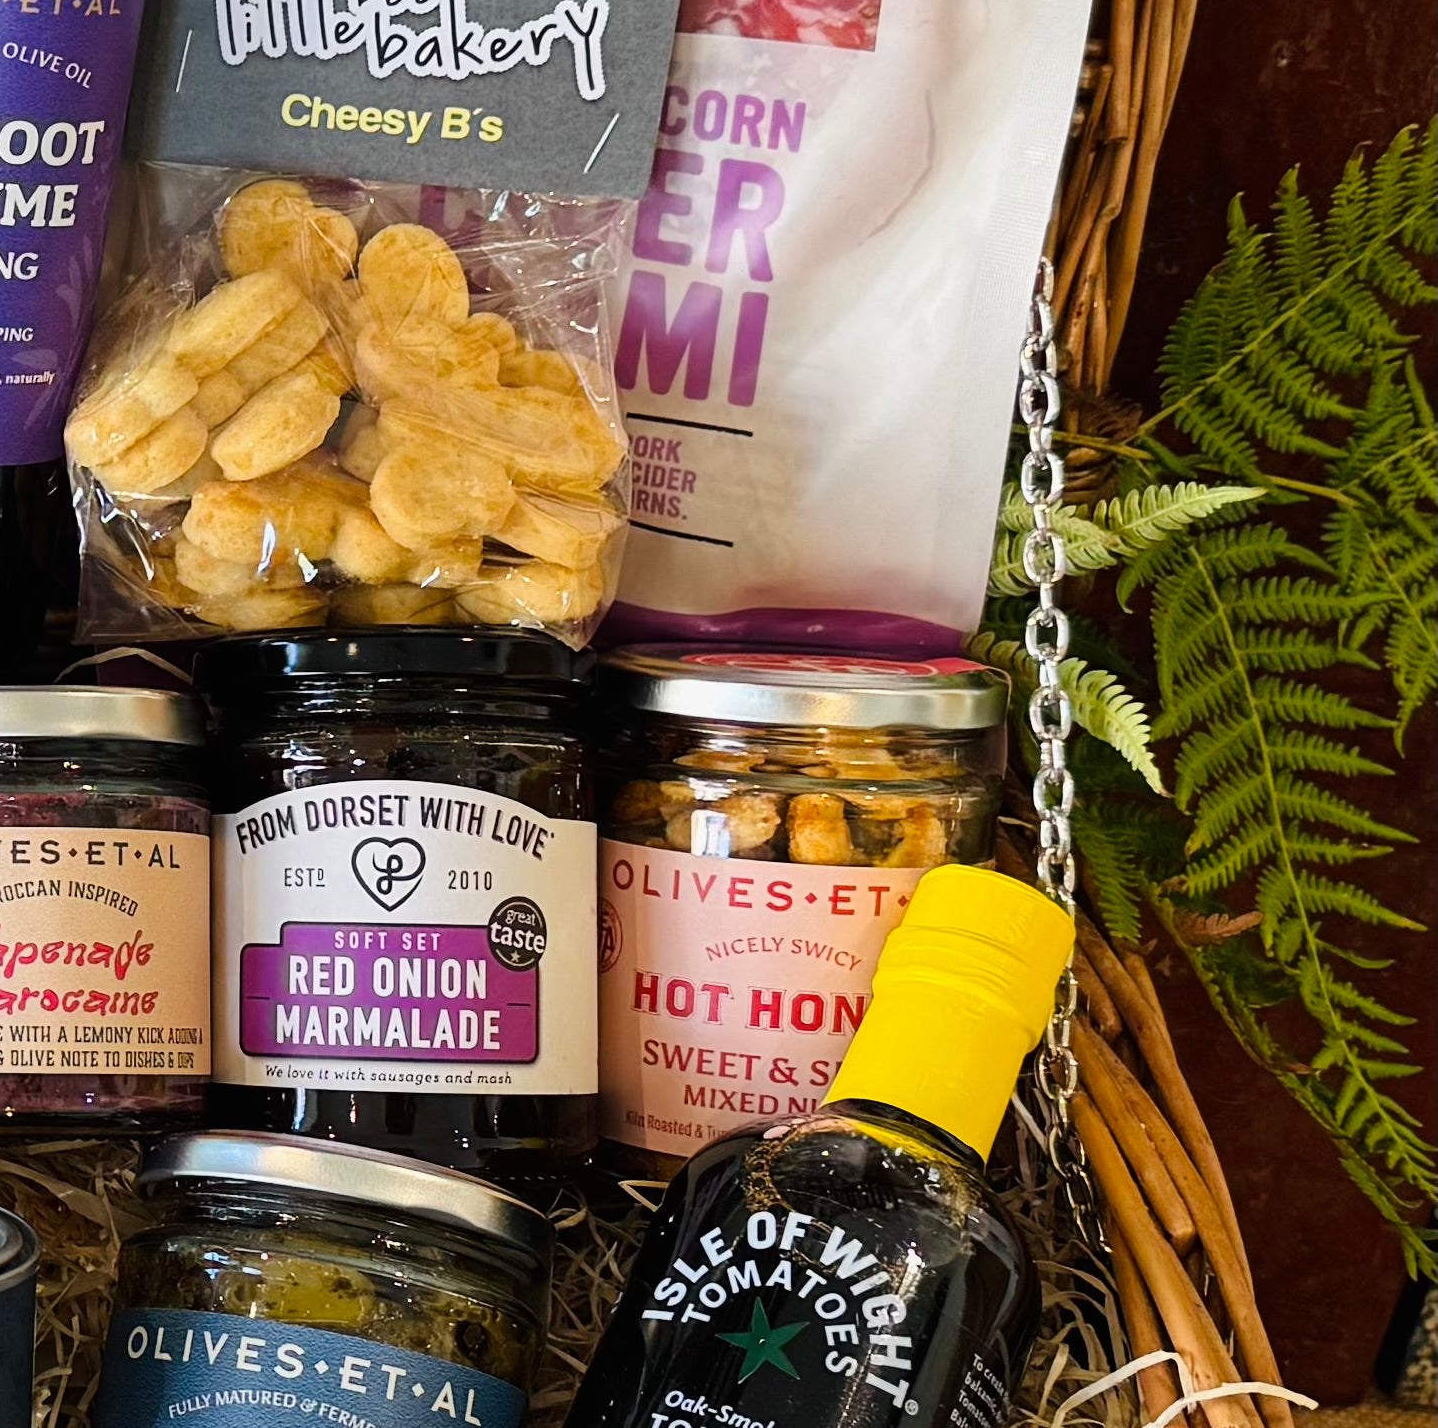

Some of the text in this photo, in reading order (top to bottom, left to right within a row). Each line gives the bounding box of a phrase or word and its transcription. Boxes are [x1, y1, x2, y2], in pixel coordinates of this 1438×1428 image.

[2, 43, 61, 73] OLIVE
[65, 62, 92, 89] OIL
[281, 94, 430, 142] Cheesy
[67, 881, 139, 917] INSPIRED
[448, 870, 493, 890] 2010
[706, 936, 863, 972] NICELY SWICY
[289, 955, 488, 1000] RED ONION
[630, 971, 735, 1026] HOT
[276, 1004, 501, 1051] MARMALADE
[10, 1051, 54, 1067] OLIVE
[60, 1051, 99, 1067] NOTE
[105, 1051, 120, 1068] TO
[125, 1051, 165, 1068] DISHES
[642, 1039, 761, 1080] SWEET
[683, 1084, 779, 1115] MIXED
